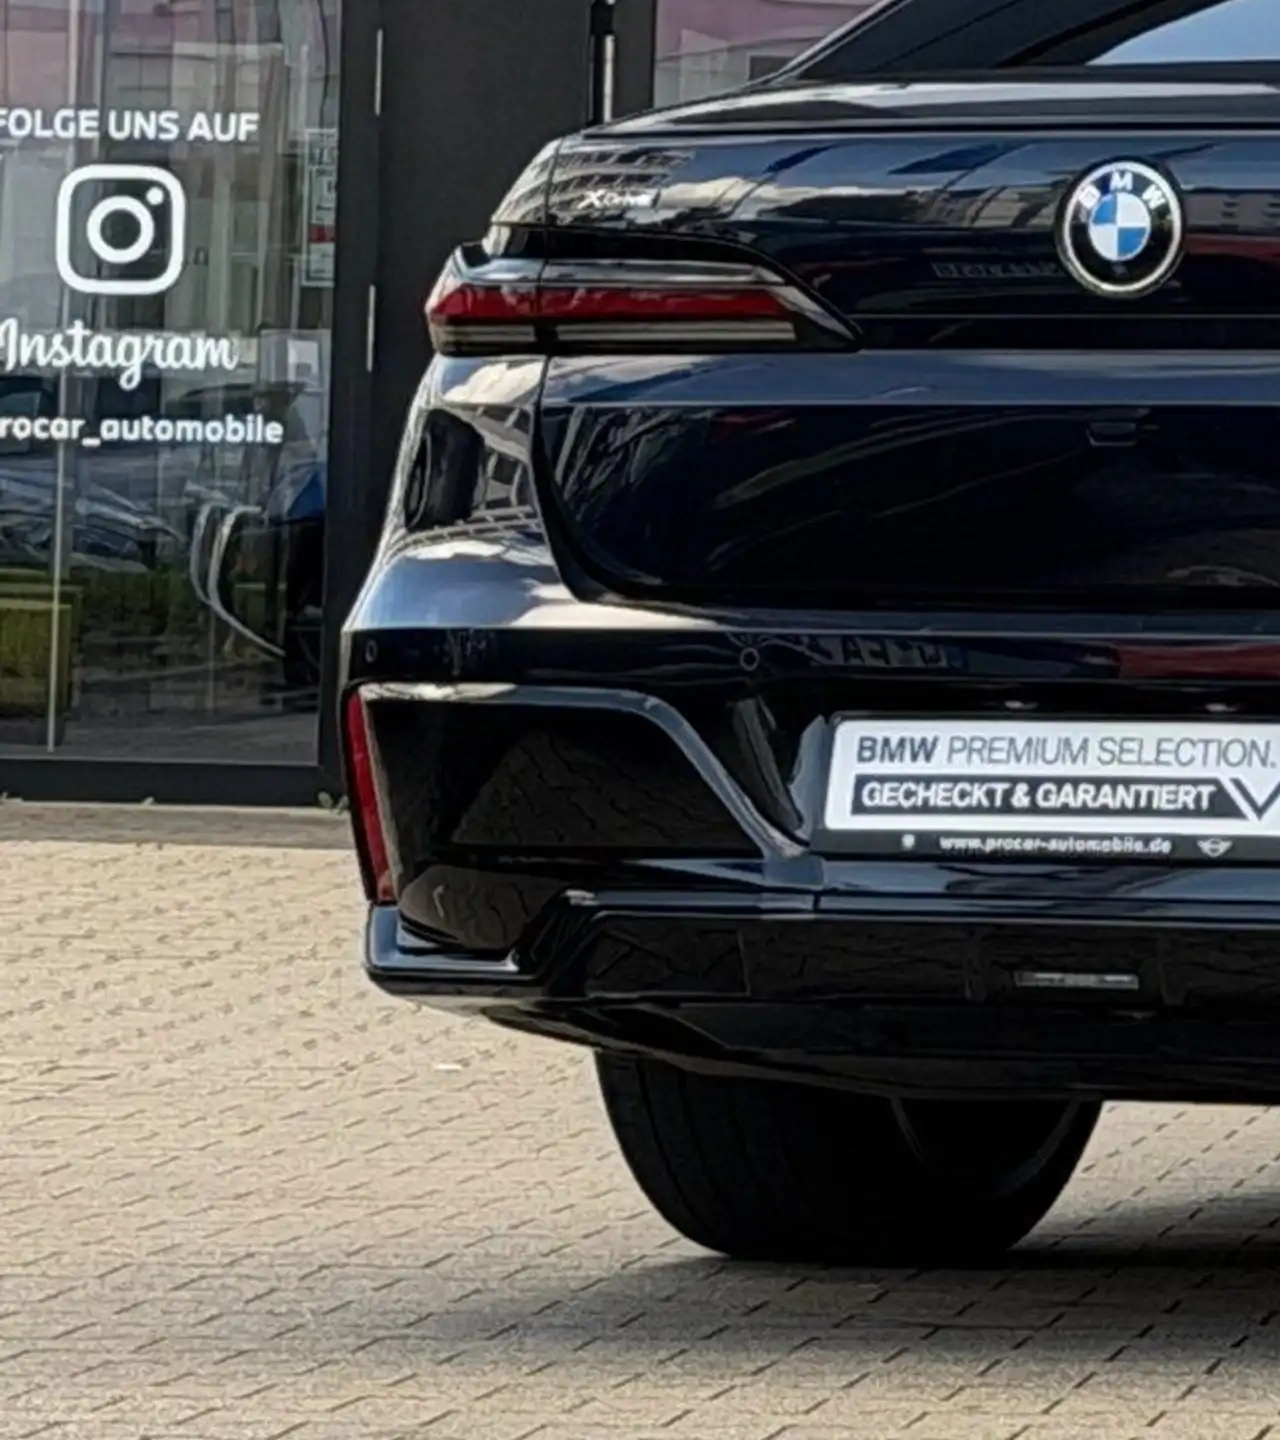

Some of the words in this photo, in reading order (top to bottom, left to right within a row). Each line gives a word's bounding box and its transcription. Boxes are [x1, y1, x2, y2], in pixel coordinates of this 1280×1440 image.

[107, 109, 180, 141] UNS
[186, 111, 261, 143] AUF
[0, 317, 240, 391] Instagram
[856, 735, 939, 764] BMW
[946, 736, 1090, 767] PREMIUM
[861, 780, 1012, 808] GECHECKT
[1010, 782, 1031, 809] &
[1034, 782, 1217, 812] GARANTIERT
